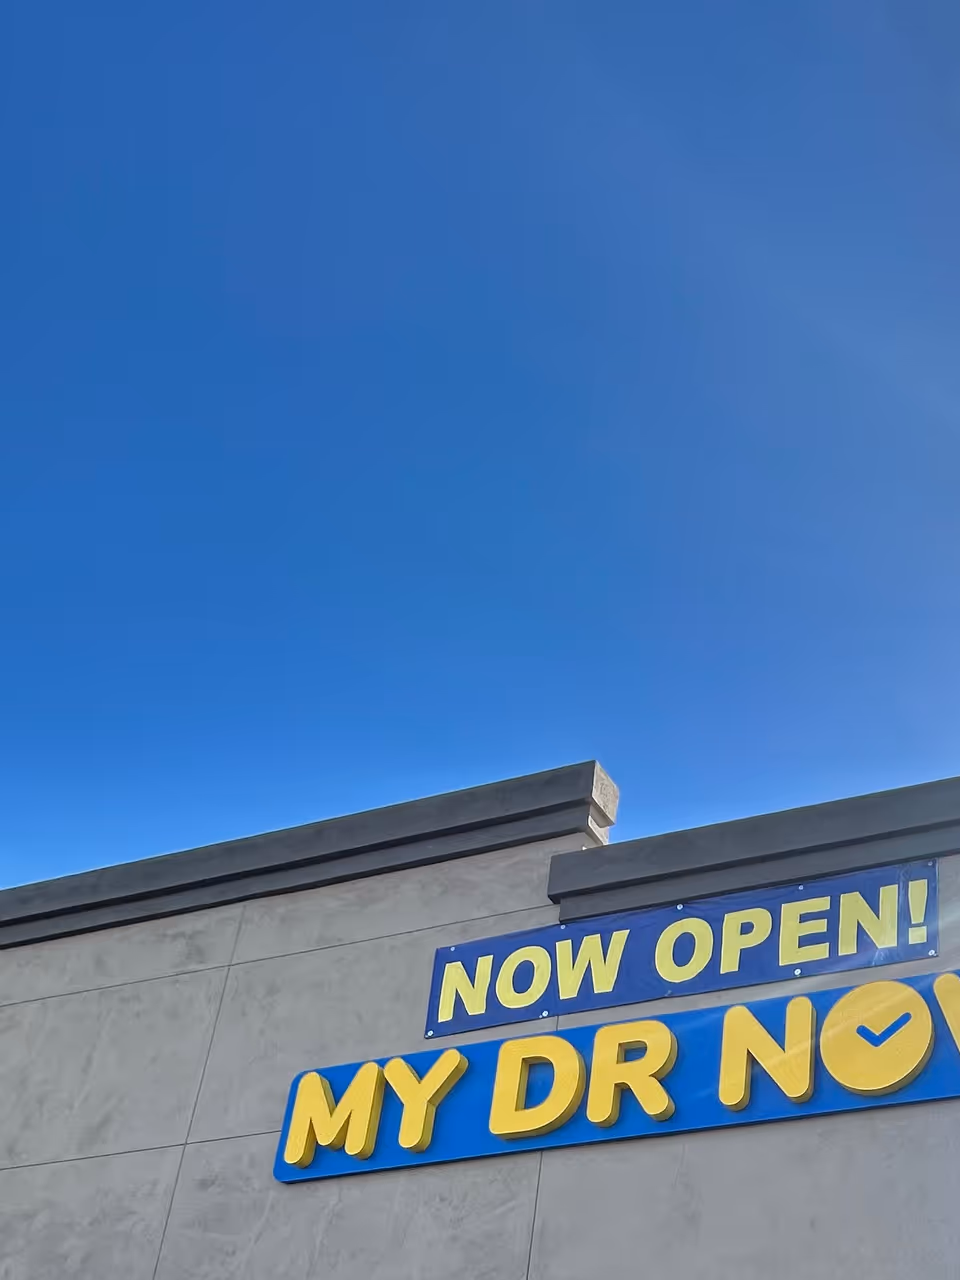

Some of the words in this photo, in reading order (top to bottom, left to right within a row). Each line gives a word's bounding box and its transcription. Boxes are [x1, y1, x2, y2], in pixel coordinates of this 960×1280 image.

[437, 929, 629, 1023] NOW
[654, 879, 928, 983] OPEN!
[283, 1047, 468, 1168] MY
[488, 1020, 678, 1140] DR
